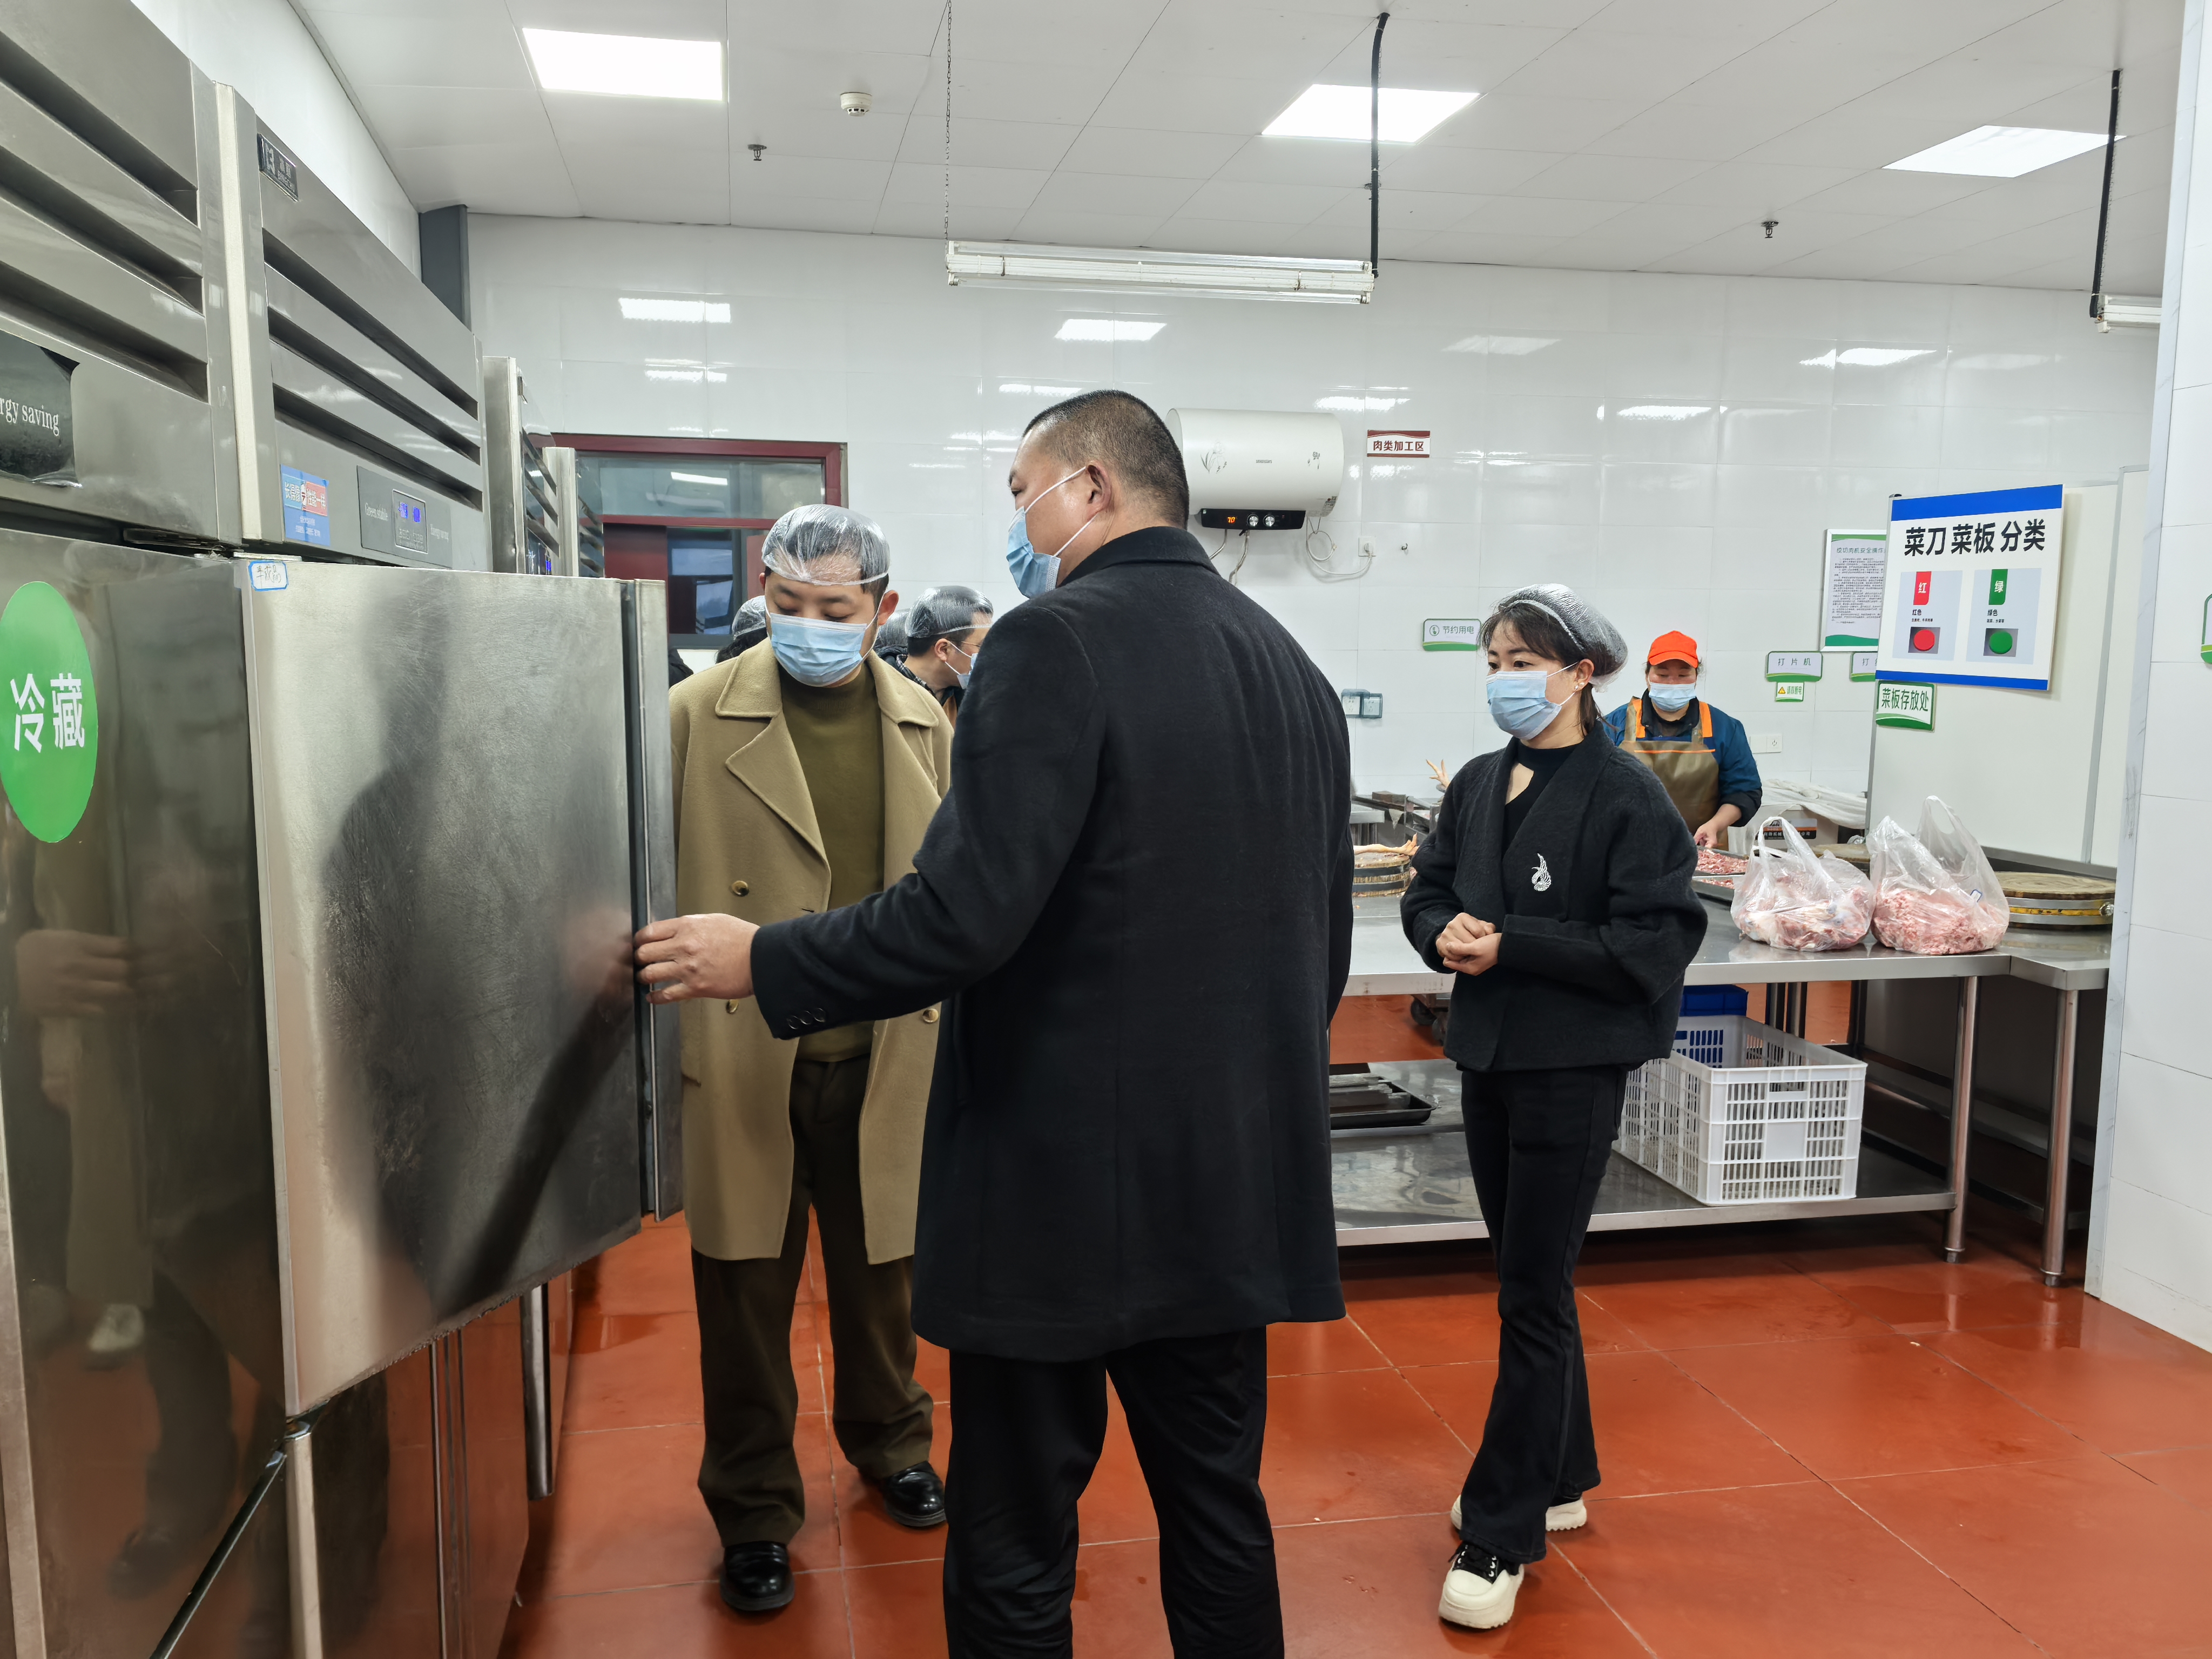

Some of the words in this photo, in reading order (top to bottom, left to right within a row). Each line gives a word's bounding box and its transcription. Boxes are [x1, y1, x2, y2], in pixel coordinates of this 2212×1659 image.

[22, 404, 59, 436] saving
[1373, 440, 1424, 451] 肉类加工区
[1904, 527, 1946, 556] 菜刀
[1951, 522, 1995, 554] 菜板
[2000, 518, 2045, 552] 分类
[1918, 582, 1927, 594] 红
[1994, 581, 2004, 593] 绿
[1442, 625, 1474, 635] 节约用电
[1778, 658, 1811, 666] 打片机
[1881, 687, 1929, 712] 菜板存放处
[10, 673, 85, 753] 冷藏
